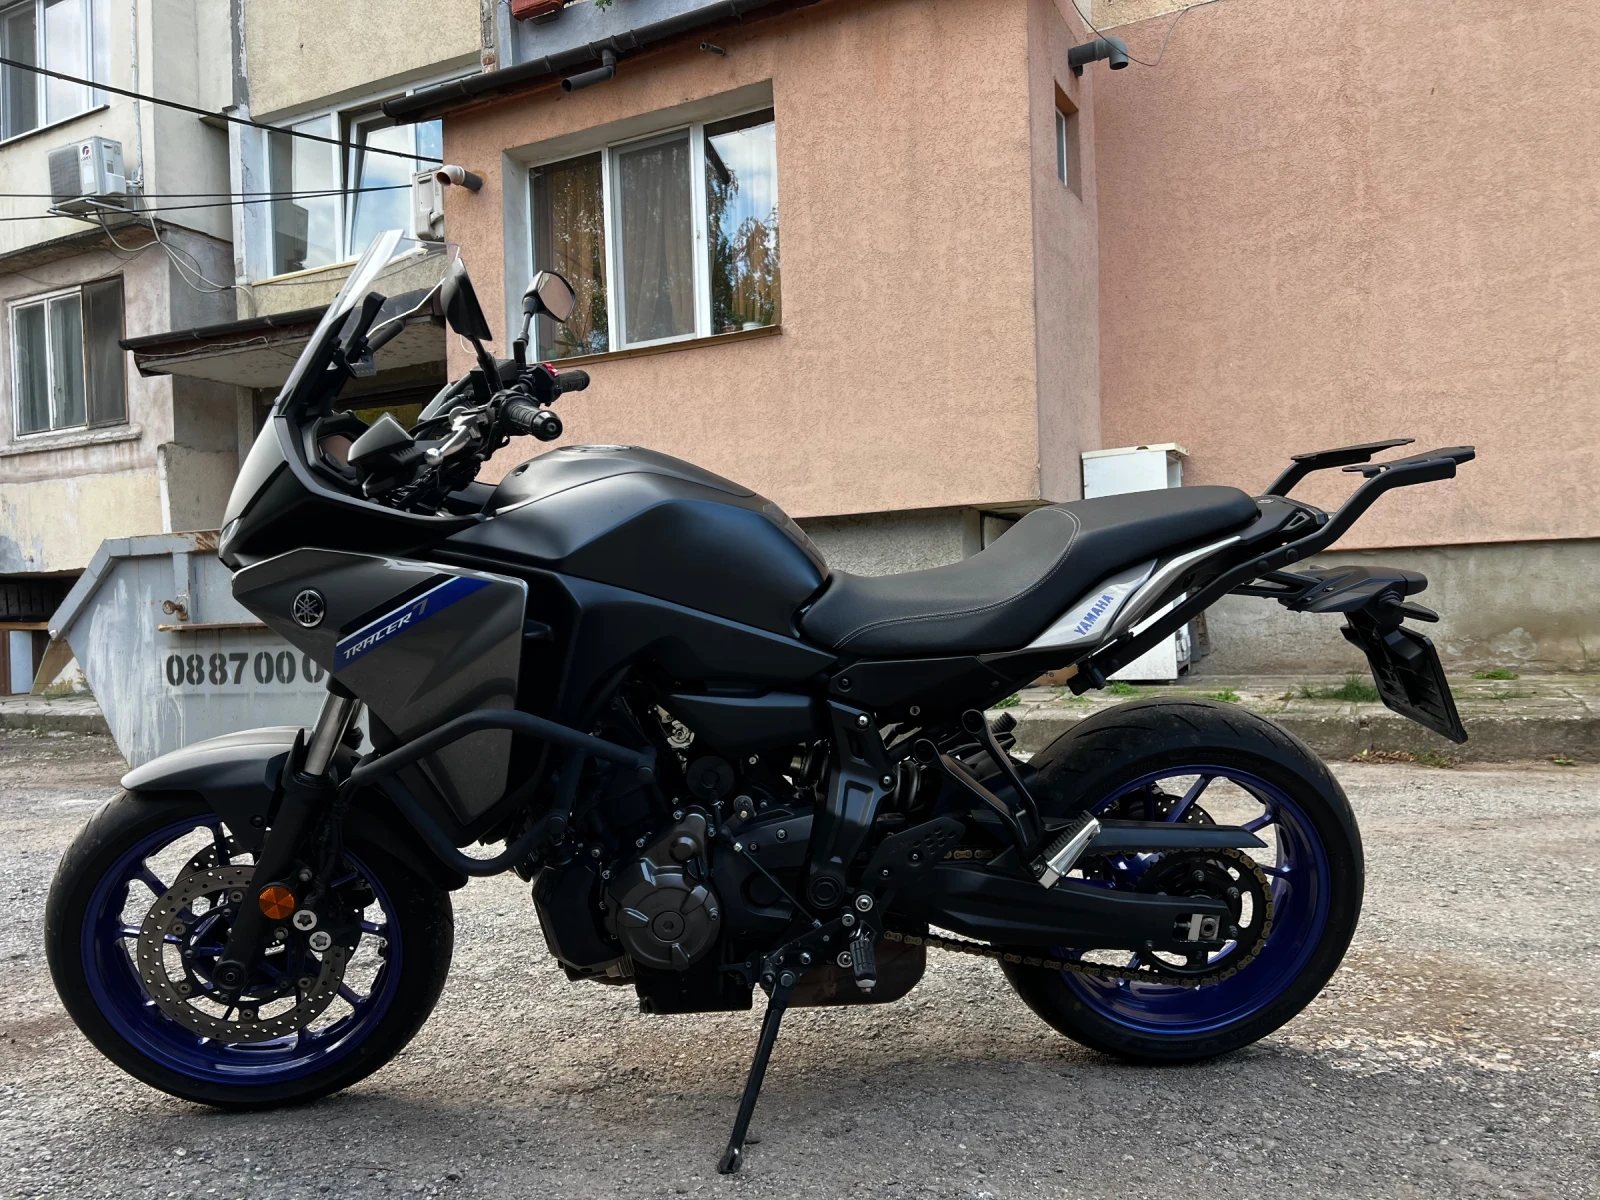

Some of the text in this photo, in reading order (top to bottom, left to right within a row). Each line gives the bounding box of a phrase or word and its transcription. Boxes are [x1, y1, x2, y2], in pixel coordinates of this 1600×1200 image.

[343, 598, 428, 660] TRACER 7
[1073, 594, 1114, 636] YAMAHA
